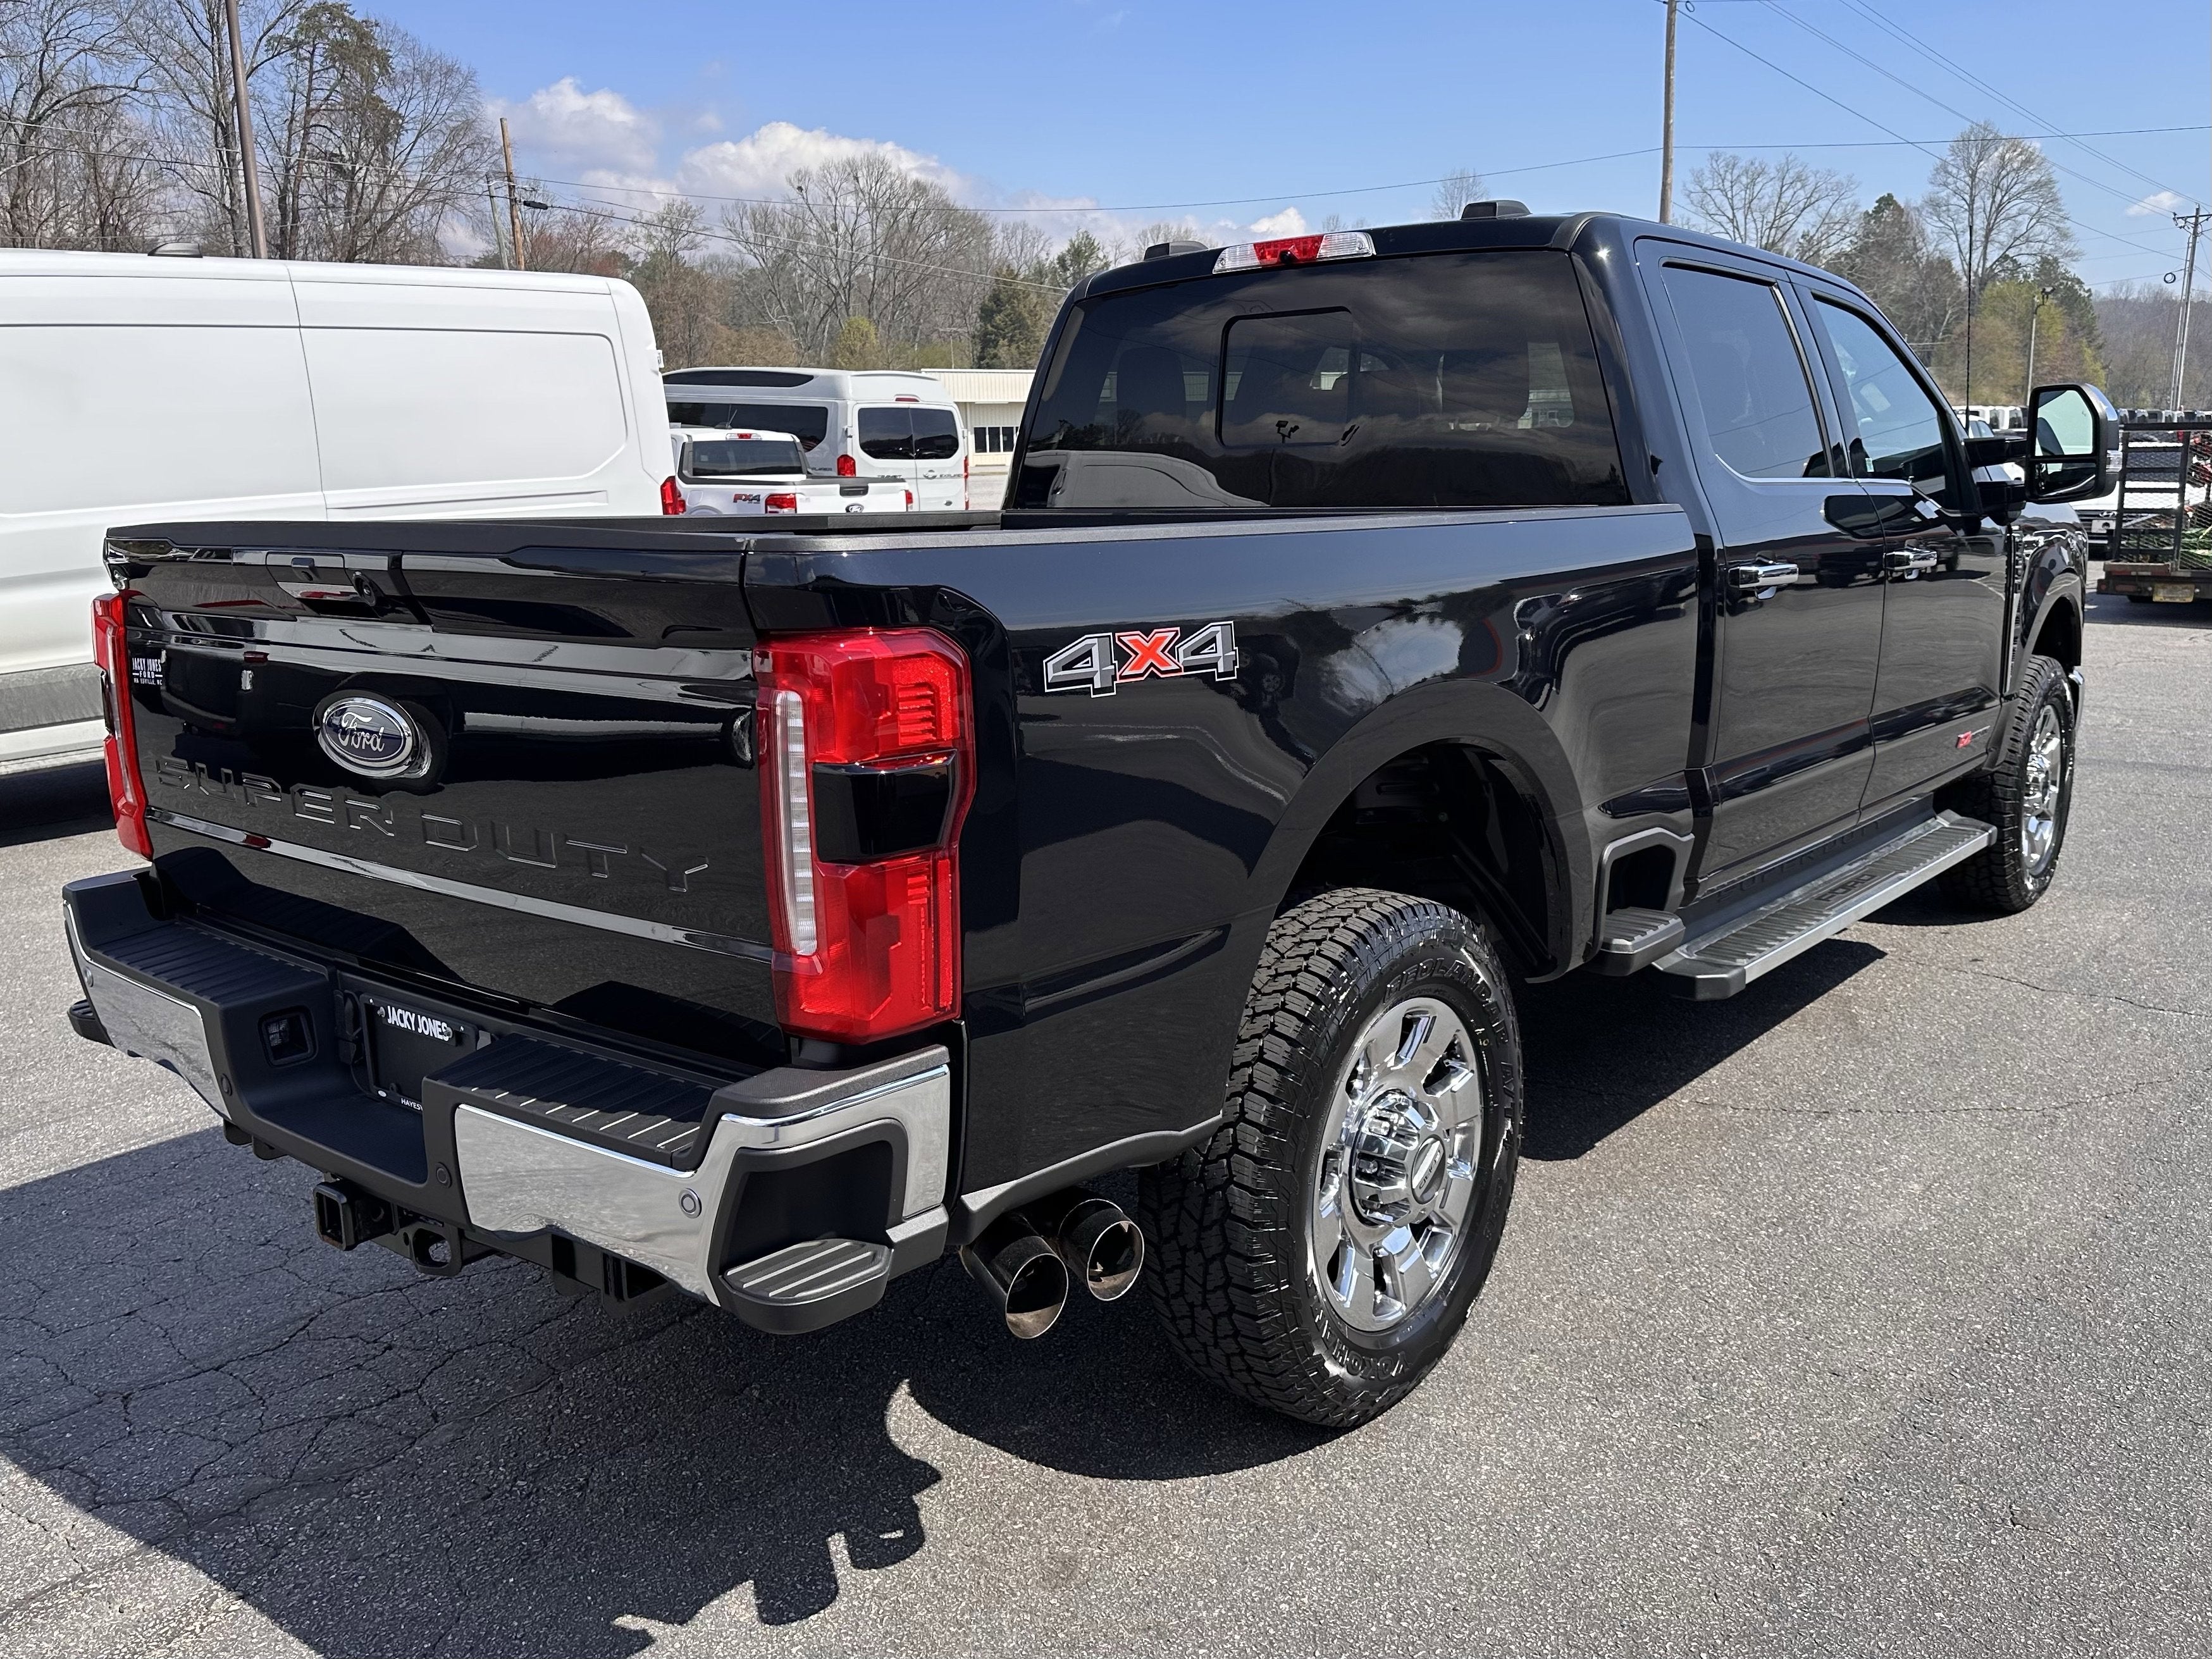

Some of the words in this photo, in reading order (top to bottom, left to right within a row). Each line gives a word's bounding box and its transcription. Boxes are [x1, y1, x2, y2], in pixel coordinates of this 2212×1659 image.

[733, 493, 761, 503] FX4
[132, 657, 146, 671] JACKY
[147, 658, 162, 672] JONES
[140, 670, 155, 679] FORD
[338, 712, 385, 752] Ford
[156, 756, 395, 836] SUPER
[421, 809, 709, 892] DUTY
[1813, 873, 1878, 903] FORD
[387, 1005, 416, 1032] JACKY
[417, 1014, 450, 1042] JONES
